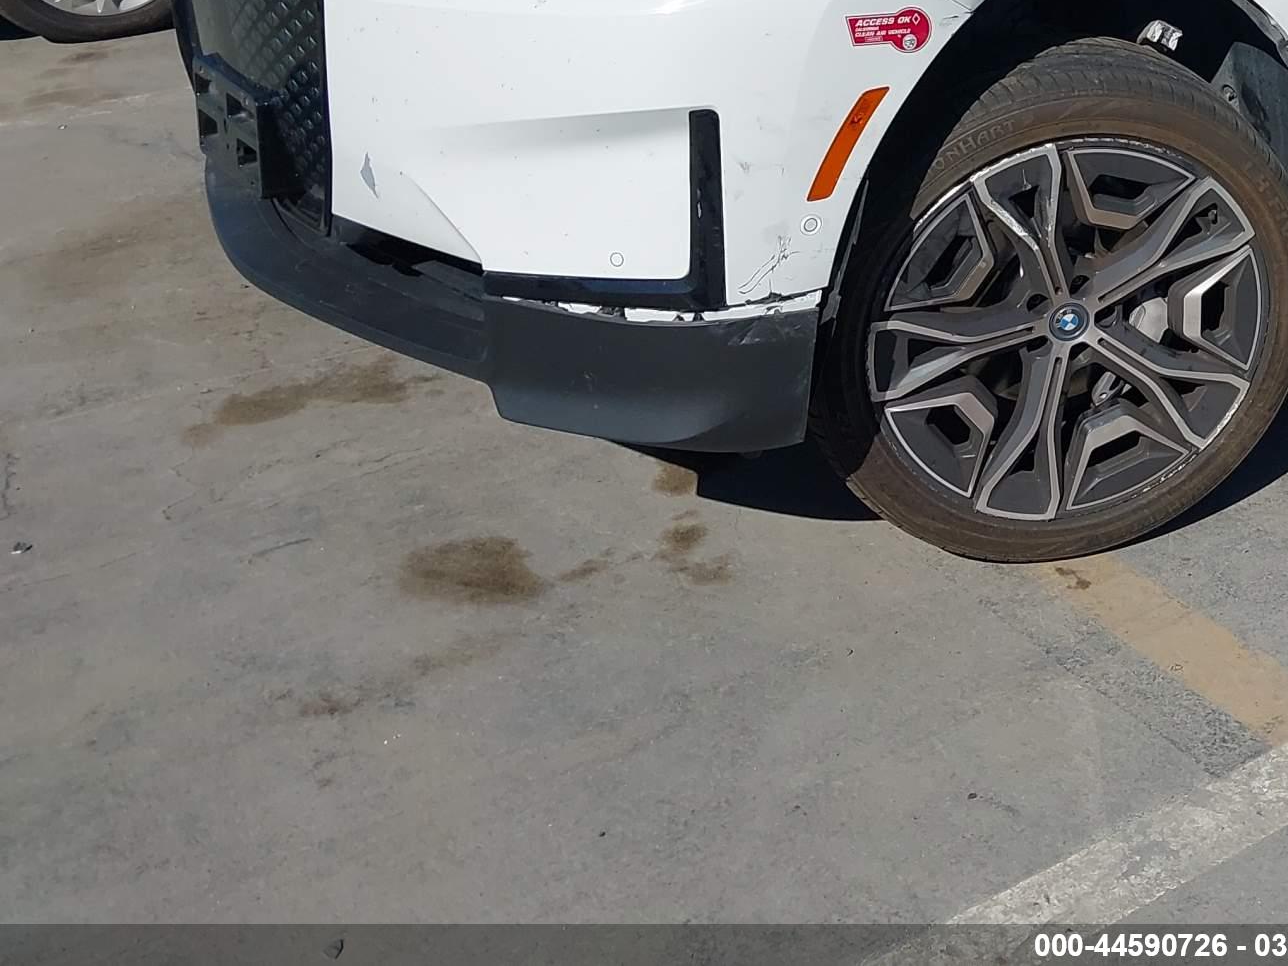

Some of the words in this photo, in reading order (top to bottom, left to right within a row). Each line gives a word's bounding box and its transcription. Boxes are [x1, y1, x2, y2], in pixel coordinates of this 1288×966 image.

[855, 17, 895, 27] ACCESS
[898, 16, 912, 24] OK
[933, 120, 1016, 171] ONHART
